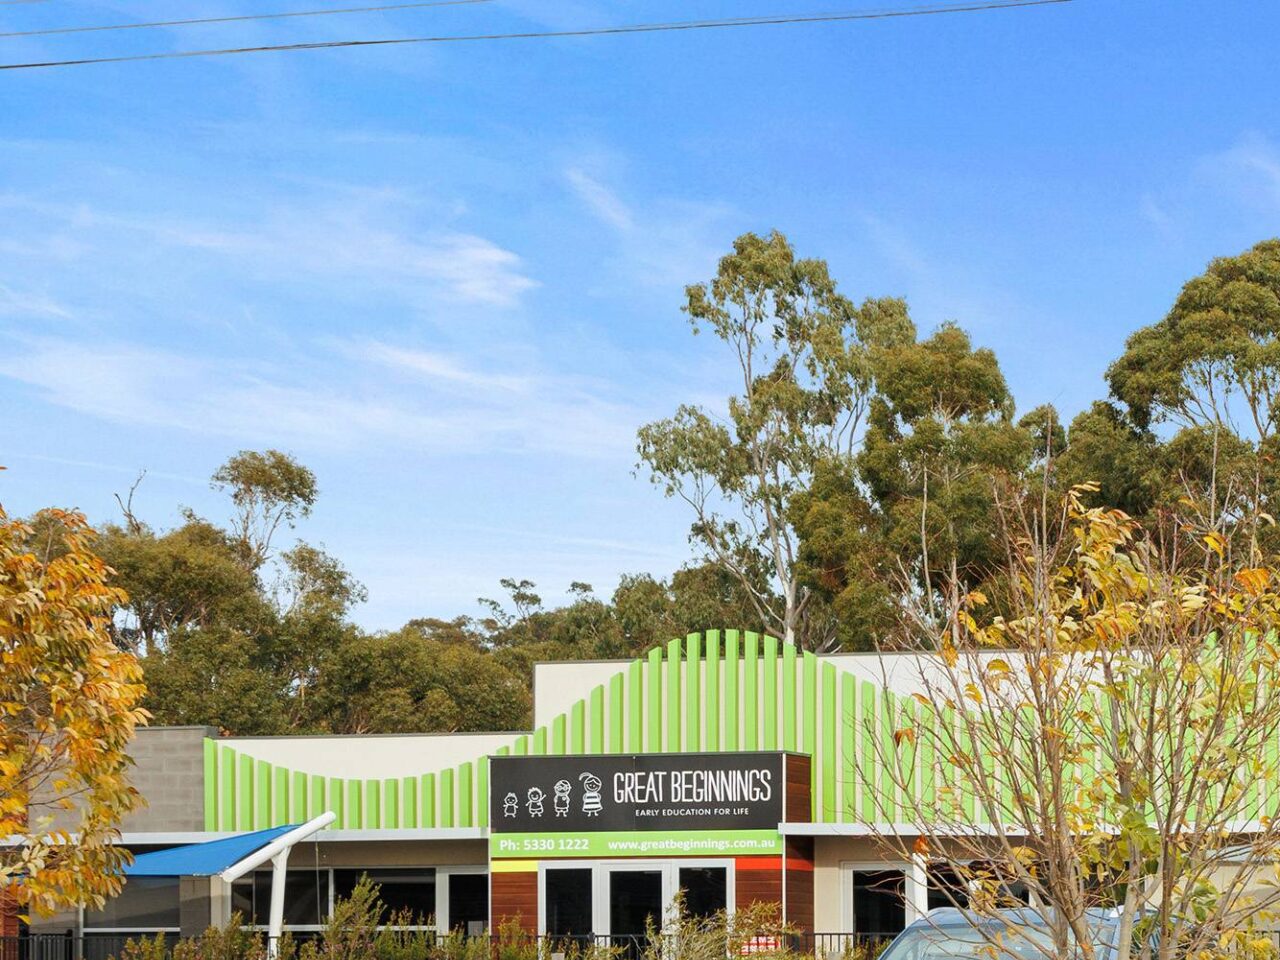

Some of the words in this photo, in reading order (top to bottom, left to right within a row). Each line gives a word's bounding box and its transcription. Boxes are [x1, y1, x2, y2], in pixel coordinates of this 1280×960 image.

[613, 771, 667, 804] GREAT
[671, 769, 772, 803] BEGINNINGS
[635, 809, 660, 817] EARLY
[662, 808, 711, 816] EDUCATION
[714, 808, 731, 816] FOR
[733, 807, 749, 816] LIFE
[499, 839, 520, 851] Ph:
[523, 839, 555, 851] 5330
[558, 839, 590, 850] 1222
[608, 838, 776, 851] www.greatbeginnings.com.au
